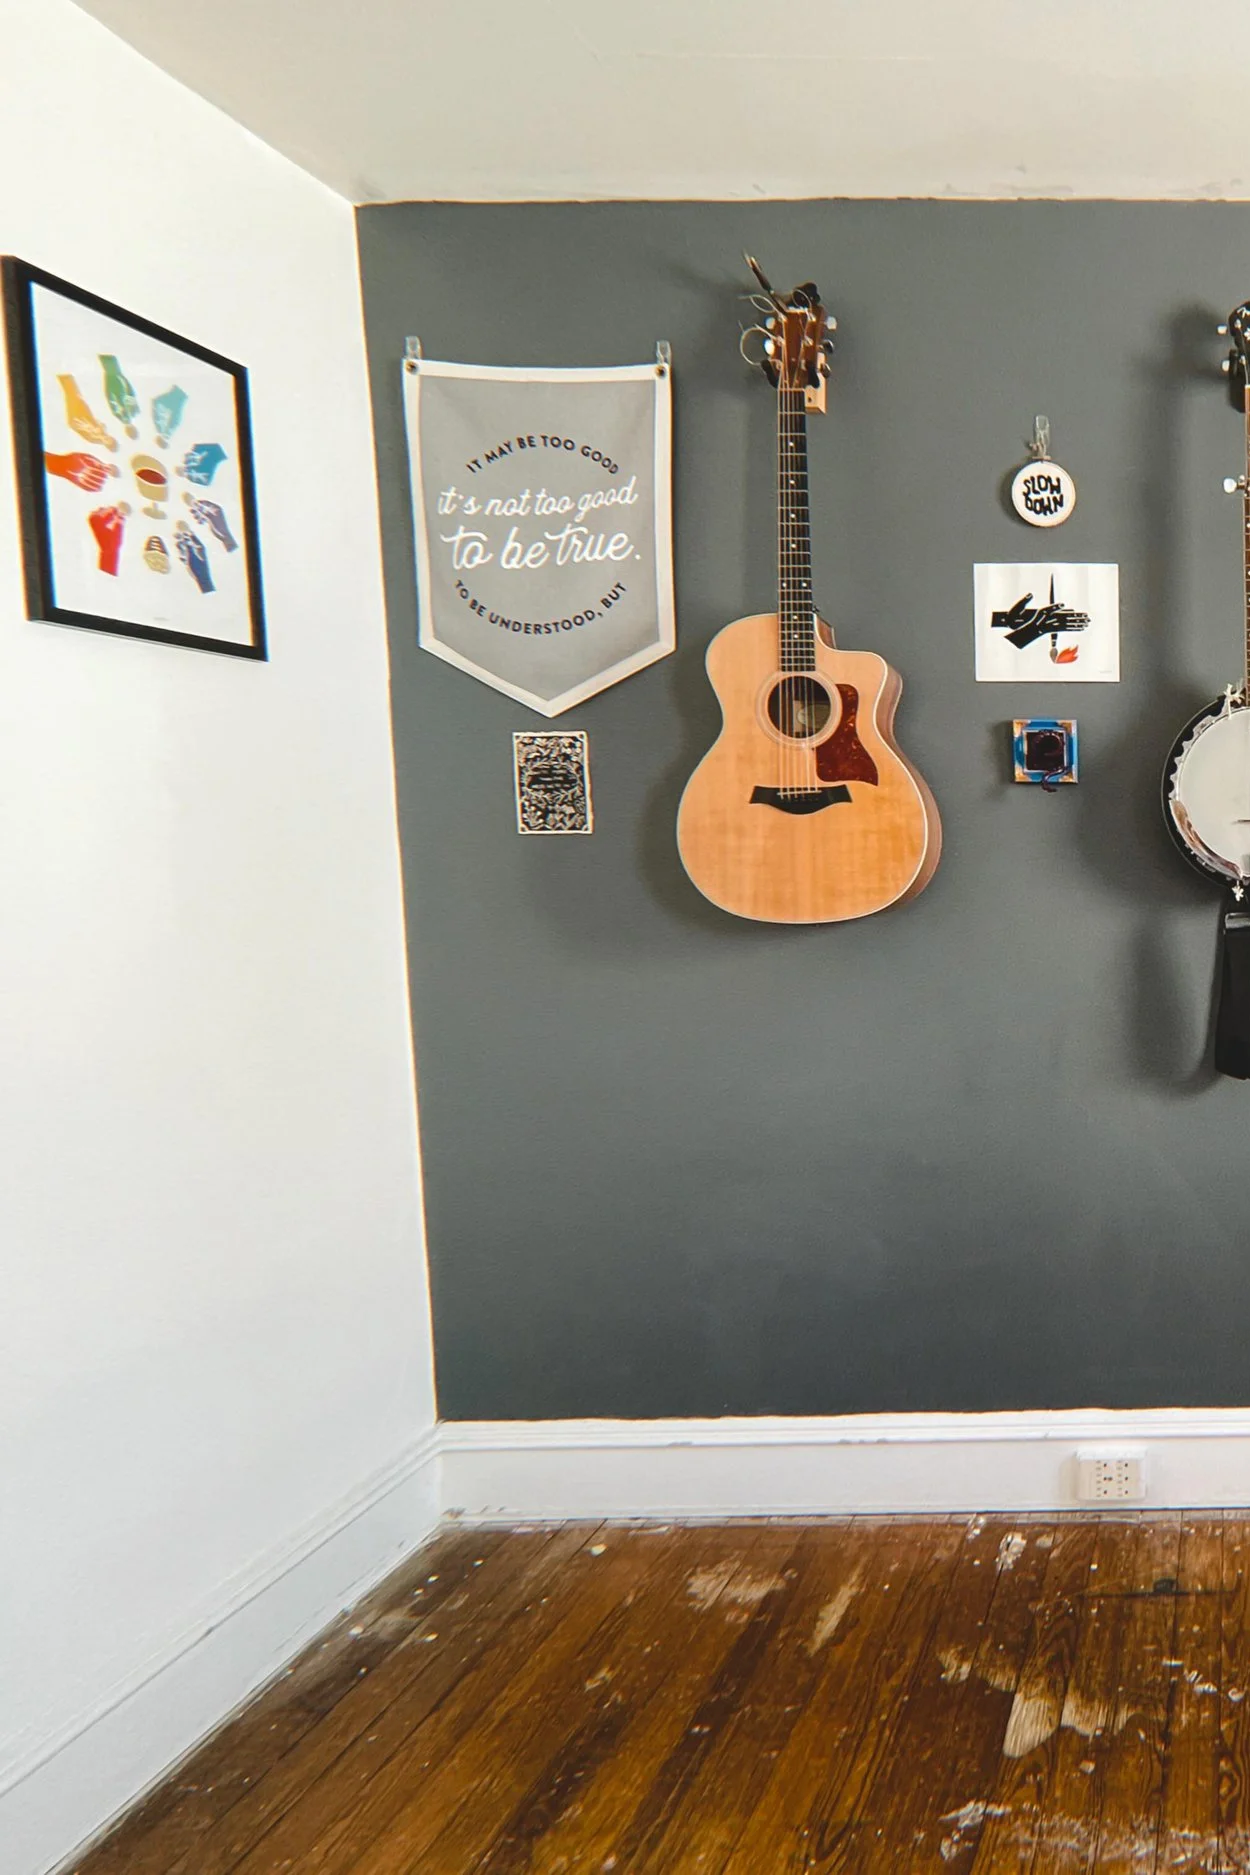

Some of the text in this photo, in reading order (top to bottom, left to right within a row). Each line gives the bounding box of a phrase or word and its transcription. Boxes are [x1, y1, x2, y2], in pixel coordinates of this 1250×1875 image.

[466, 434, 619, 475] IT MAY BE TOO GOOD
[438, 475, 639, 523] it's not too good
[1022, 475, 1061, 496] SLOW
[1025, 494, 1064, 516] DOWN
[440, 523, 641, 570] to be true.
[454, 579, 627, 635] TO BE UNDERSTOOD, BUT
